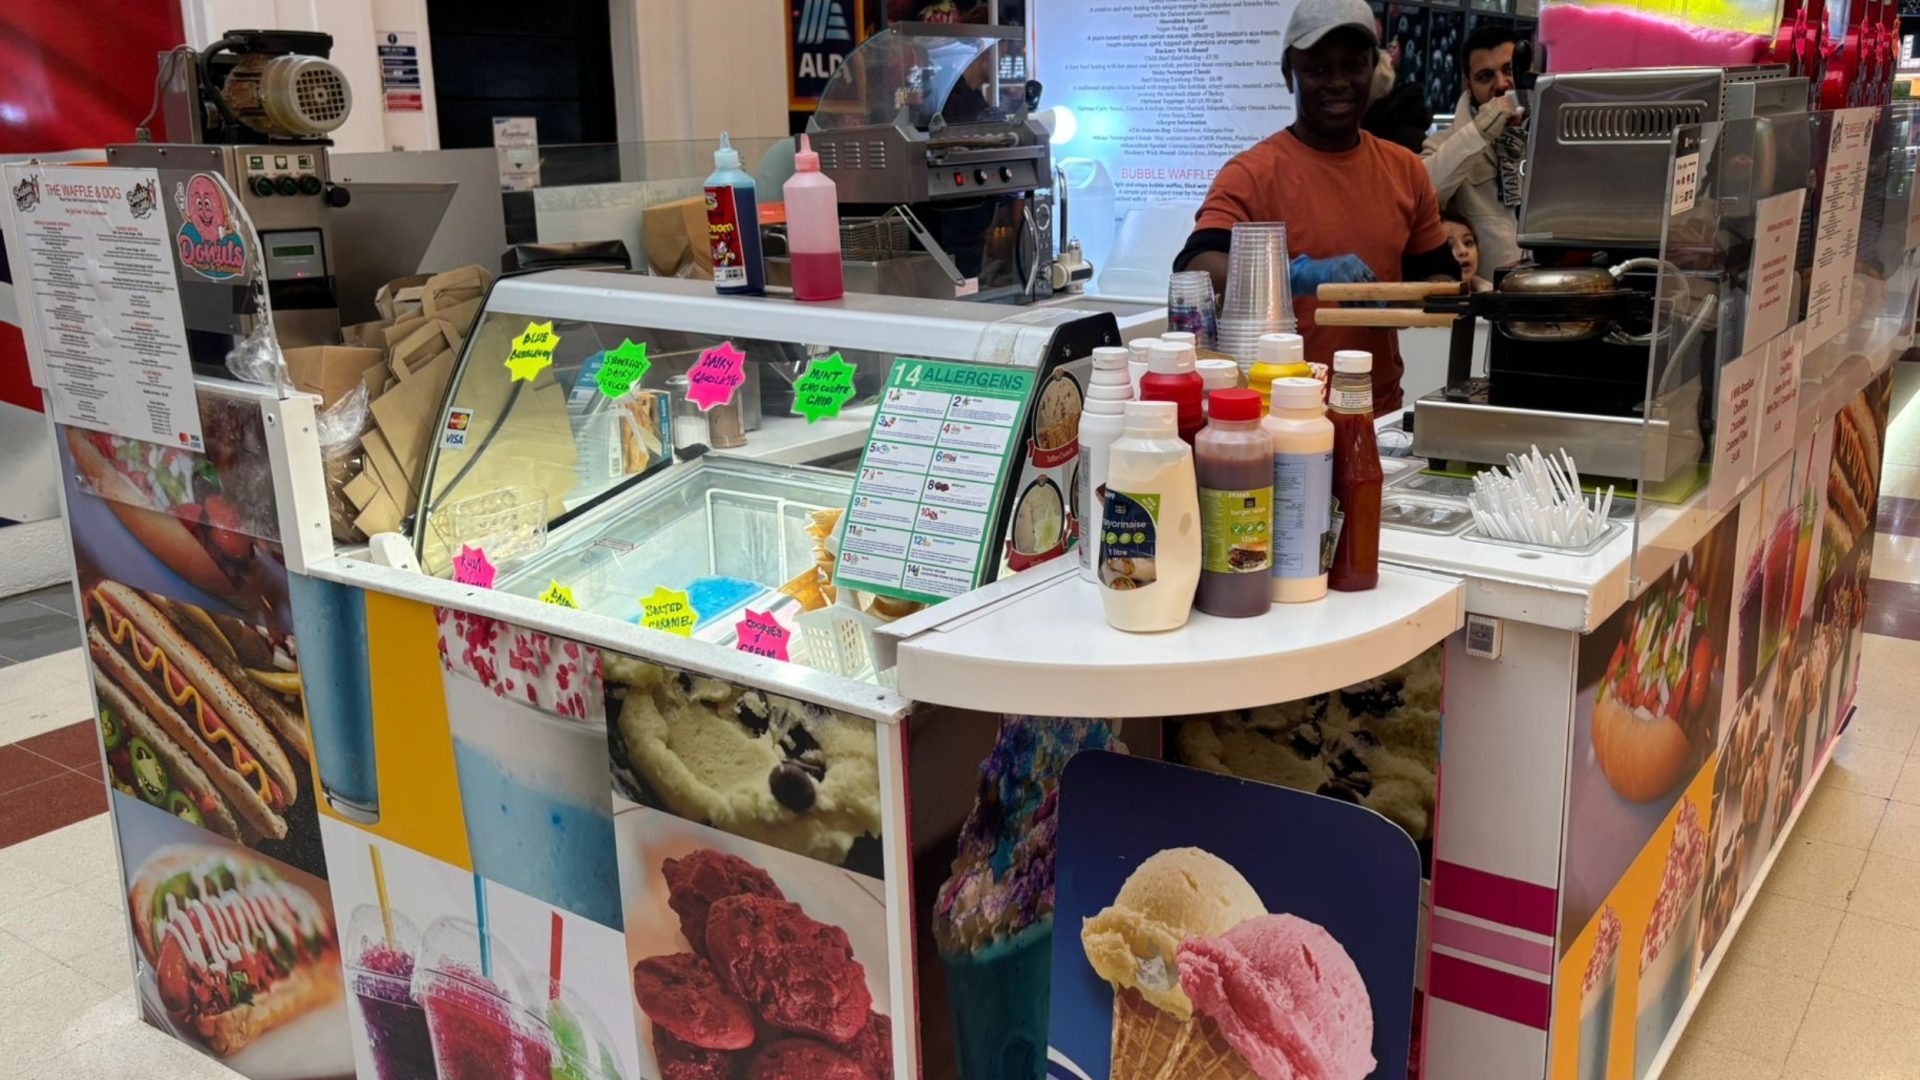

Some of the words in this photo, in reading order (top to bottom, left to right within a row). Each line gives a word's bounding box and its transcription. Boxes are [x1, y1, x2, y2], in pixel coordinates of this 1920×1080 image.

[798, 52, 849, 80] ALD
[1121, 168, 1166, 180] BUBBLE
[44, 184, 60, 197] THE
[62, 184, 92, 199] WAFFLE
[95, 186, 101, 198] &
[102, 186, 122, 200] DOG
[179, 235, 244, 268] Donuts
[523, 332, 548, 345] BLUE
[703, 354, 734, 373] DAIRY
[809, 369, 843, 382] MINT
[894, 363, 922, 387] 14
[923, 368, 1024, 390] ALLERGENS
[806, 395, 833, 406] CHIP
[888, 391, 893, 399] 1
[953, 396, 961, 407] 2
[879, 416, 886, 427] 3
[943, 423, 950, 434] 4
[446, 433, 464, 445] VISA
[869, 443, 876, 453] 5
[936, 451, 944, 462] 6
[862, 469, 869, 480] 7
[927, 479, 935, 490] 8
[854, 497, 861, 507] 9
[921, 507, 930, 517] 10
[1231, 509, 1251, 517] burger
[1103, 519, 1147, 529] ayonnaise
[848, 525, 856, 535] 11
[913, 535, 923, 545] 12
[842, 552, 851, 562] 13
[455, 555, 477, 573] RUM
[907, 564, 915, 574] 14
[645, 602, 683, 617] SALTED
[746, 619, 783, 638] COOKIES
